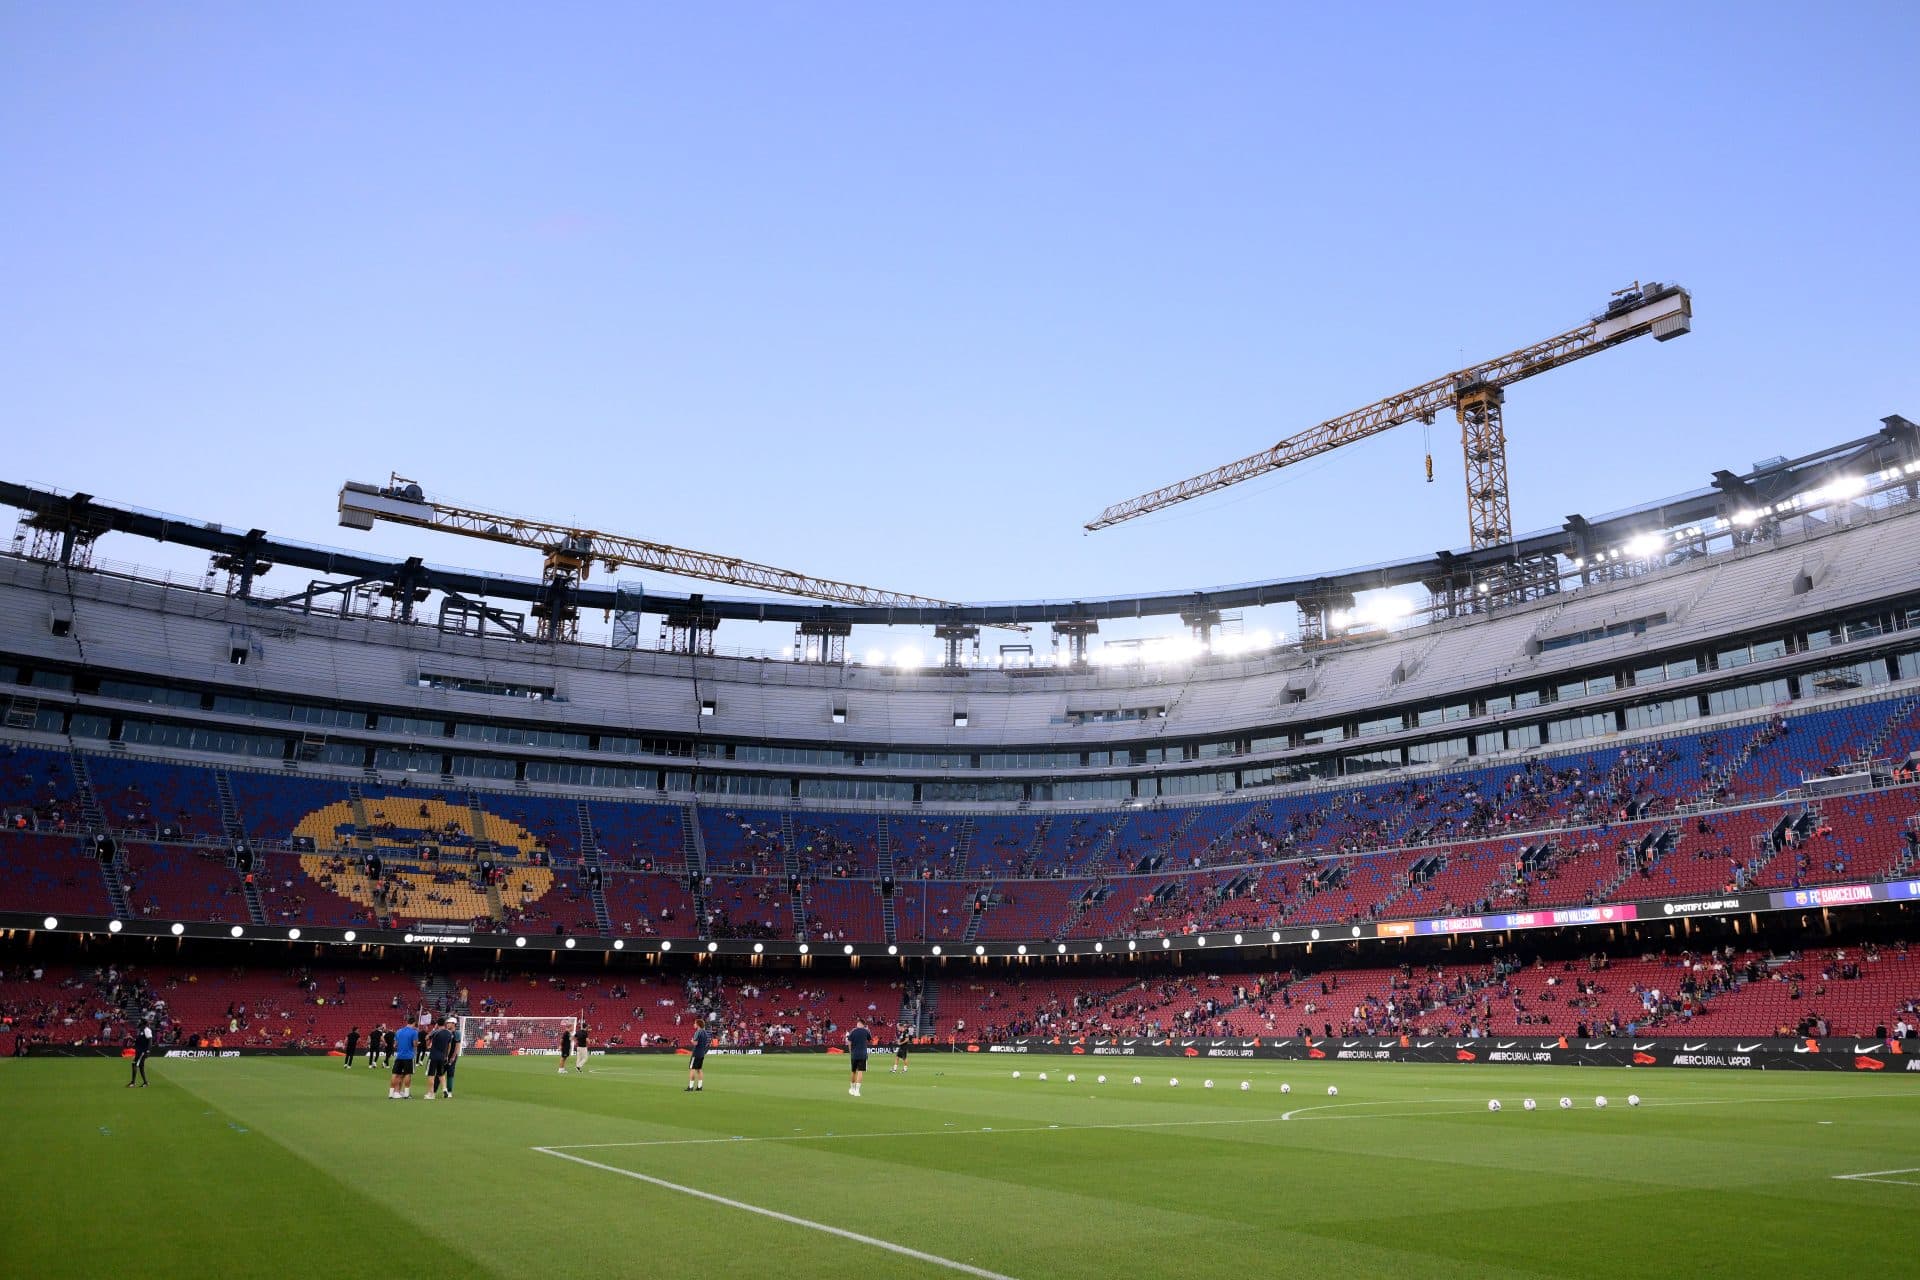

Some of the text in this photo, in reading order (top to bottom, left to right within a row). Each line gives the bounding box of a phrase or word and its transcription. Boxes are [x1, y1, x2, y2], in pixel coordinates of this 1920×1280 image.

[1809, 885, 1873, 904] FC BARCELONA
[1674, 902, 1702, 912] SPOTIFY
[1440, 917, 1483, 931] FC BARCELONA
[413, 935, 439, 943] SPOTIFY
[164, 1049, 216, 1058] MERCURIAL
[1208, 1049, 1240, 1057] MERCURIAL
[1337, 1050, 1374, 1059] MERCURIAL
[1488, 1051, 1532, 1061] MERCURIAL
[1672, 1054, 1752, 1066] MERCURIAL VAPOR
